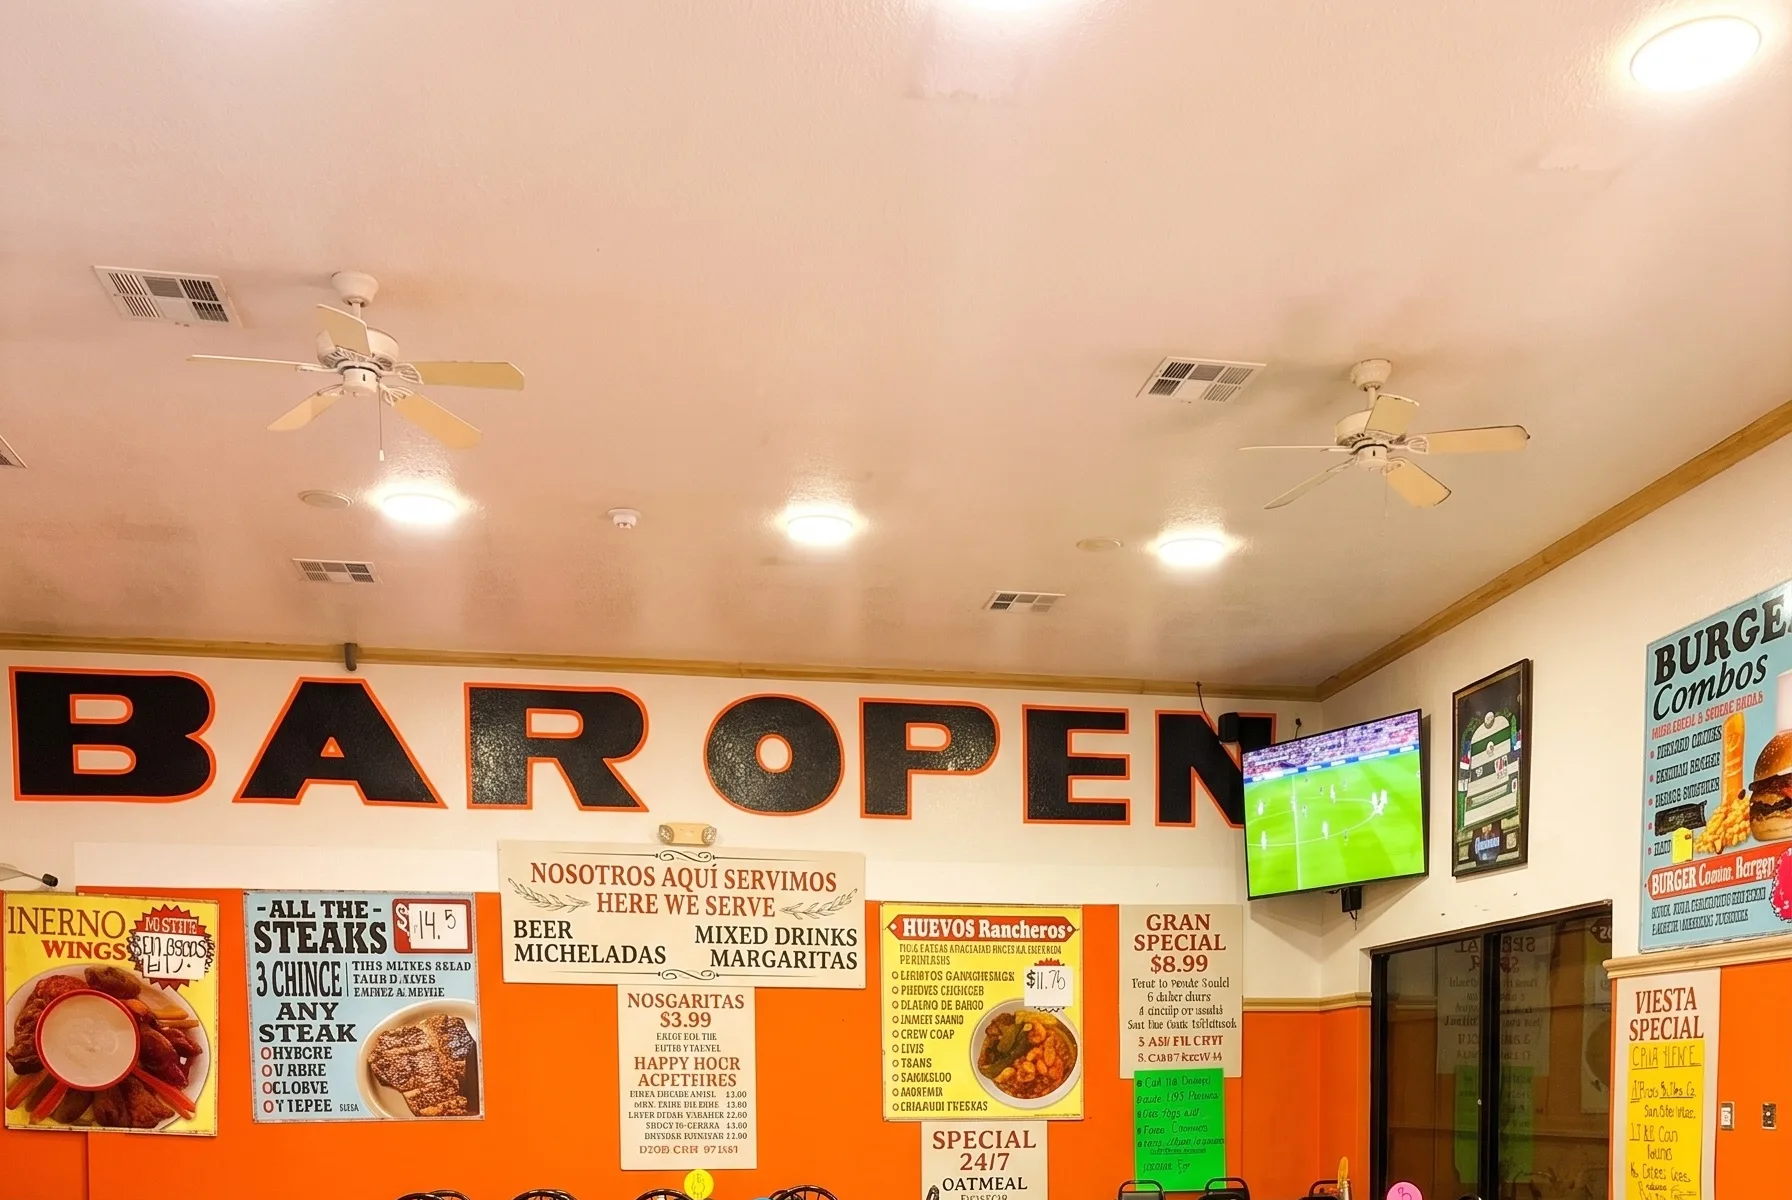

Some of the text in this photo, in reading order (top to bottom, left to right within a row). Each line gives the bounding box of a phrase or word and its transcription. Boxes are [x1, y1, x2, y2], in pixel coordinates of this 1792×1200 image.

[1654, 594, 1792, 686] BURGE
[1653, 654, 1768, 720] Combos
[9, 665, 1276, 829] BAR OPEN
[530, 862, 837, 893] NOSOTROS AQUÍ SERVIMOS
[1651, 865, 1698, 896] BURGER
[269, 900, 369, 919] ALL THE
[596, 892, 775, 917] HERE WE SERVE
[7, 906, 126, 939] INERNO
[902, 917, 1066, 939] HUEVOS Rancheros
[1145, 913, 1211, 932] GRAN
[254, 921, 388, 955] STEAKS
[514, 920, 858, 947] BEER MIXED DRINKS
[1134, 933, 1227, 952] SPECIAL
[41, 941, 129, 961] WINGS
[514, 943, 857, 970] MICHELADAS MARGARITAS
[1150, 953, 1209, 974] $8.99
[262, 962, 344, 997] 3 CHINCE
[275, 1002, 339, 1020] ANY
[627, 992, 745, 1009] NOSGARITAS
[941, 1000, 953, 1010] DE
[1635, 986, 1698, 1015] VIESTA
[659, 1012, 712, 1028] $3.99
[1629, 1015, 1705, 1042] SPECIAL
[258, 1023, 357, 1043] STEAK
[901, 1029, 955, 1040] CREW COAP
[634, 1056, 741, 1071] HAPPY HOCR
[932, 1130, 1037, 1150] SPECIAL
[942, 1177, 1028, 1191] OATMEAL
